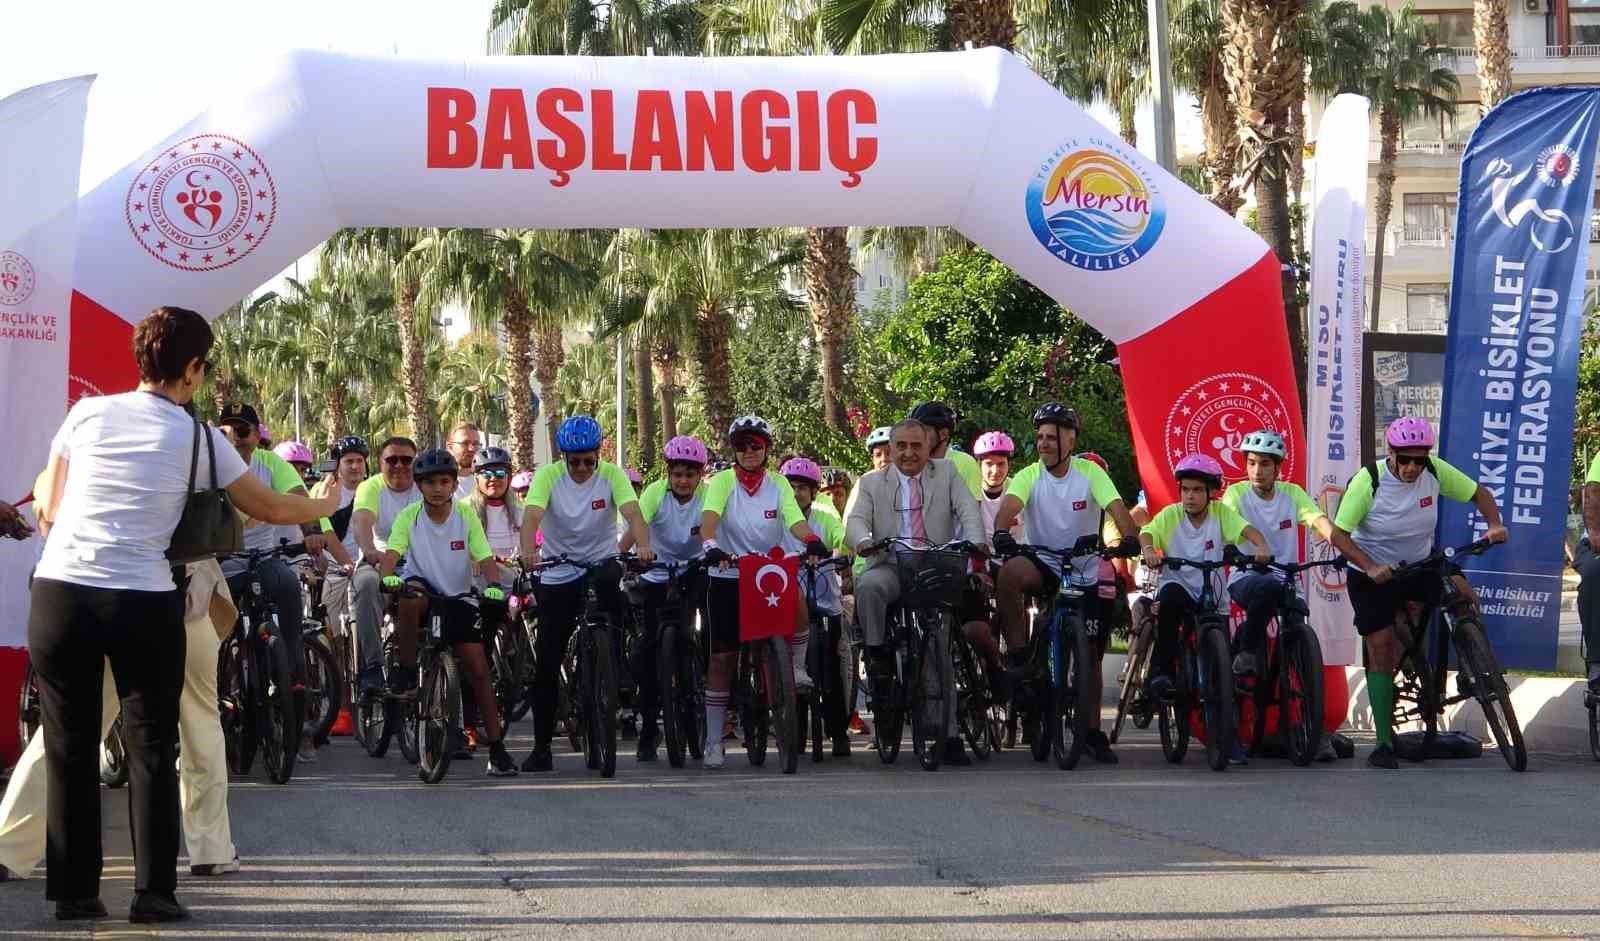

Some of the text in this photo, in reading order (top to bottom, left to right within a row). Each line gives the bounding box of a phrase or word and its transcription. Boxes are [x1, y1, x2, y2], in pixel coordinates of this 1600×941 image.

[427, 87, 878, 188] BAŞLANGIÇ
[182, 156, 221, 167] GENÇLİK
[223, 163, 235, 175] VE
[231, 174, 249, 198] SPOR
[217, 199, 249, 243] BAKANLIĞI
[158, 217, 193, 246] TÜRKİYE
[1047, 236, 1140, 270] VALİLİĞİ
[0, 311, 57, 327] NÇLİK VE
[1479, 255, 1525, 400] BİSİKLET
[0, 327, 57, 342] AKANLIĞI
[1399, 386, 1441, 400] MERCE
[1396, 400, 1424, 417] YENİ
[1511, 287, 1559, 525] FEDERASYONU
[1188, 405, 1215, 457] MHURİYETİ
[1215, 399, 1253, 409] GENÇLİK
[1253, 404, 1264, 417] VE
[1495, 587, 1553, 602] BİSİKLET
[1480, 602, 1545, 618] MSİLCİLİĞİ
[1086, 618, 1099, 635] 35
